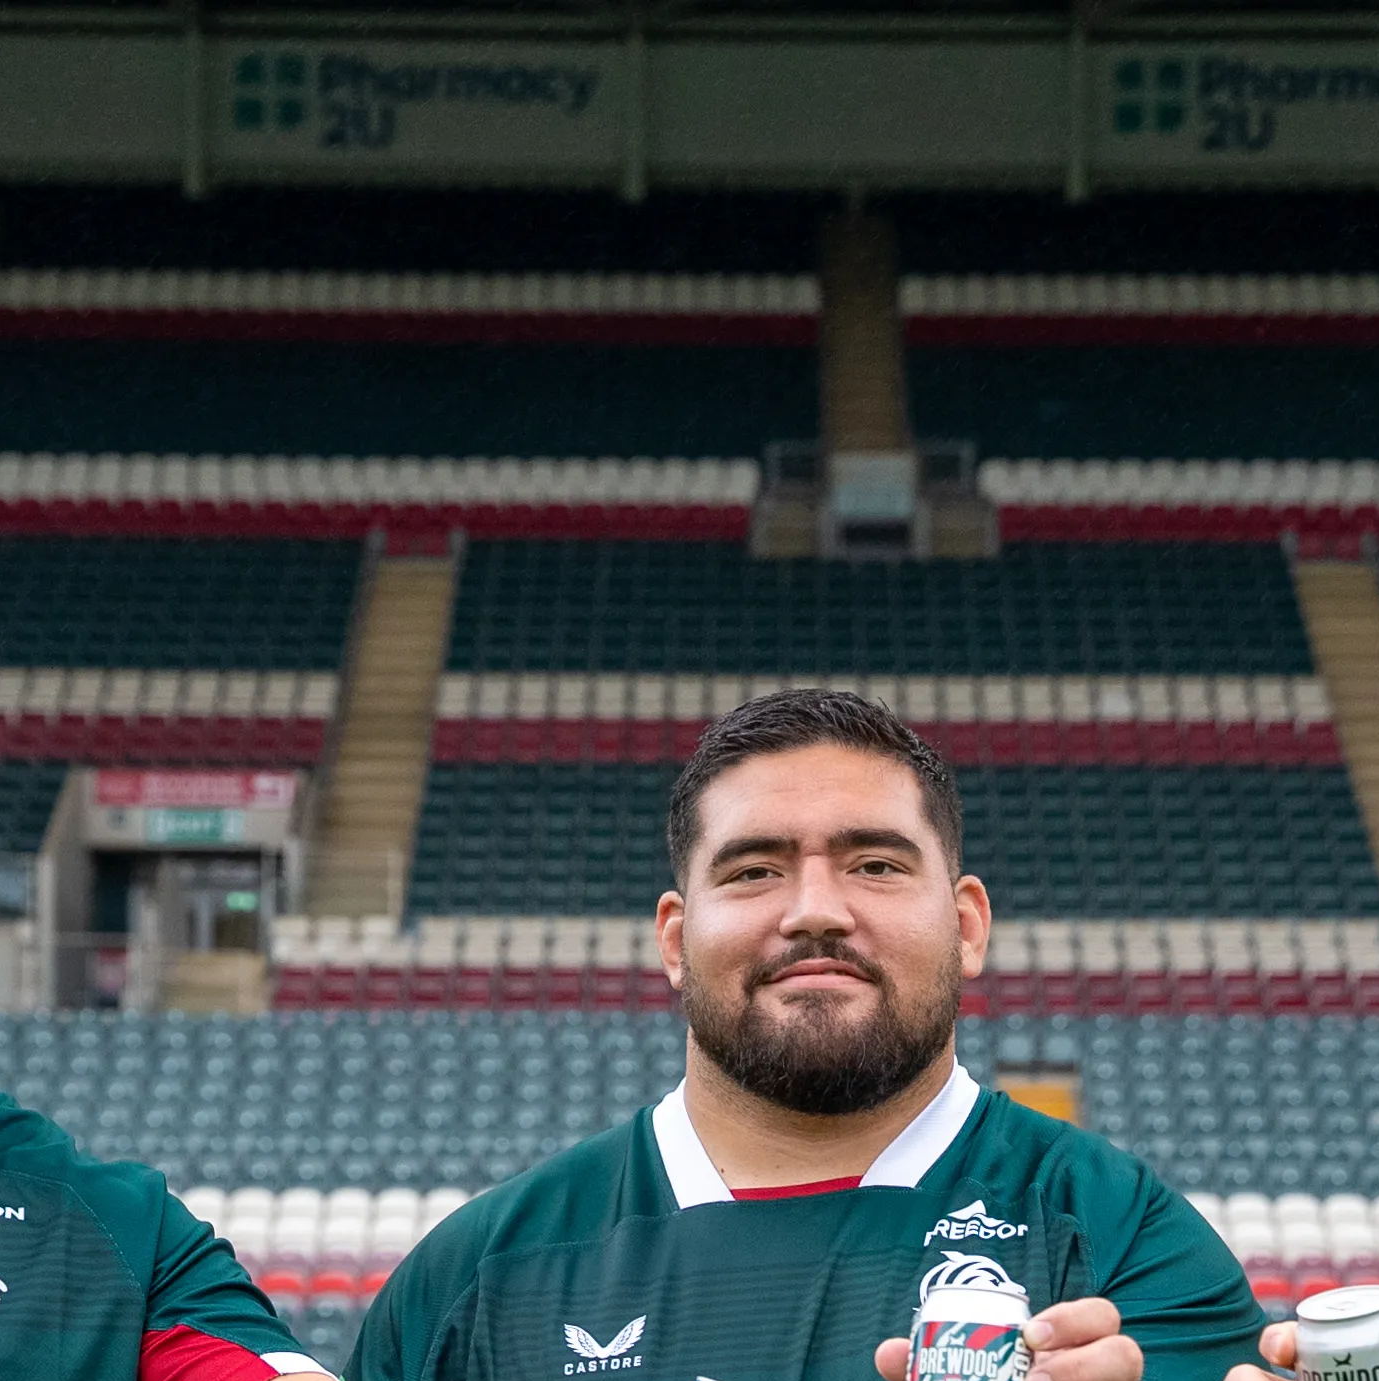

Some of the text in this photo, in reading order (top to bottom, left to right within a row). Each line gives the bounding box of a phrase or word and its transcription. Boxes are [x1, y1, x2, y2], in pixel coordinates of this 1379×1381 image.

[319, 53, 601, 115] Pharmacy
[321, 104, 396, 149] 2U
[1202, 106, 1275, 150] 2U
[565, 1355, 642, 1376] CASTORE
[920, 1346, 998, 1380] BREWDOG
